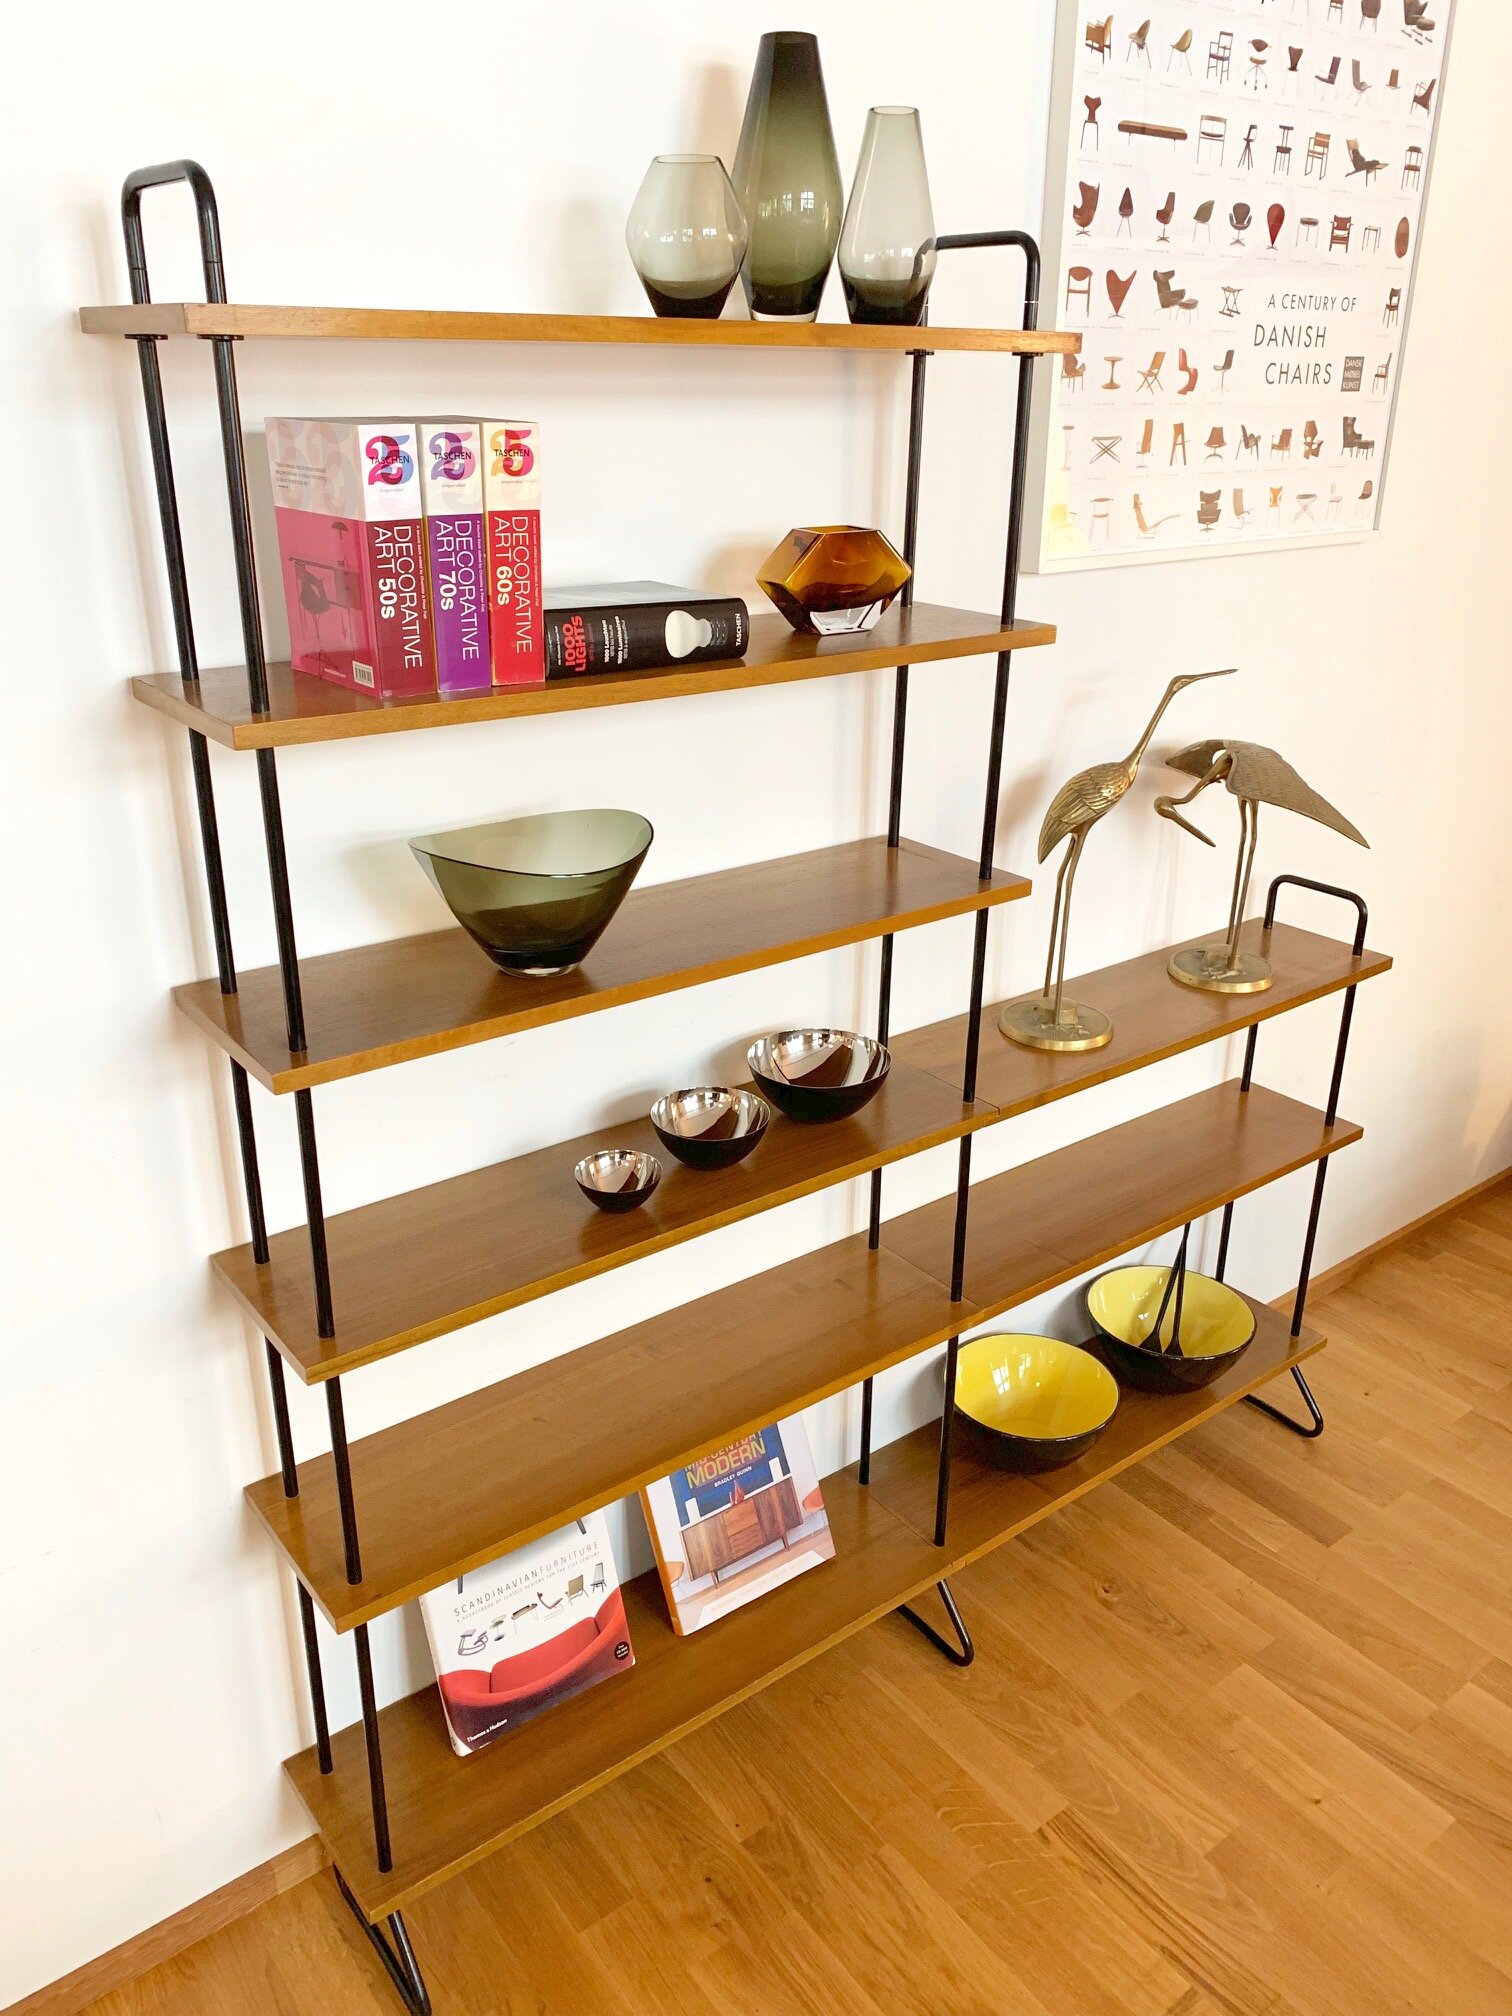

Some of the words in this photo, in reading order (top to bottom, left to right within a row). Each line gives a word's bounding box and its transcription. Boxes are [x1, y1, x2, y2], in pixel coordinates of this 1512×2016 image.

[1267, 294, 1276, 308] A
[1281, 294, 1337, 311] CENTURY
[1341, 297, 1357, 312] OF
[1253, 324, 1327, 348] DANISH
[1265, 362, 1332, 385] CHAIRS
[370, 455, 410, 465] TASCHEN
[433, 452, 472, 461] TASCHEN
[494, 448, 530, 458] TASCHEN
[374, 526, 395, 574] ART
[435, 521, 455, 567] ART
[494, 516, 512, 562] ART
[378, 578, 396, 620] 50s
[393, 525, 423, 668] DECORATIVE
[439, 570, 457, 611] 70s
[454, 520, 480, 661] DECORATIVE
[496, 566, 512, 606] 60s
[512, 516, 533, 654] DECORATIVE
[562, 623, 576, 667] 1000
[571, 615, 587, 672] LIGHTS
[734, 613, 742, 647] TASCHEN
[686, 1437, 766, 1490] MODERN
[714, 1474, 736, 1488] BRADLEY
[736, 1466, 752, 1477] QUINN
